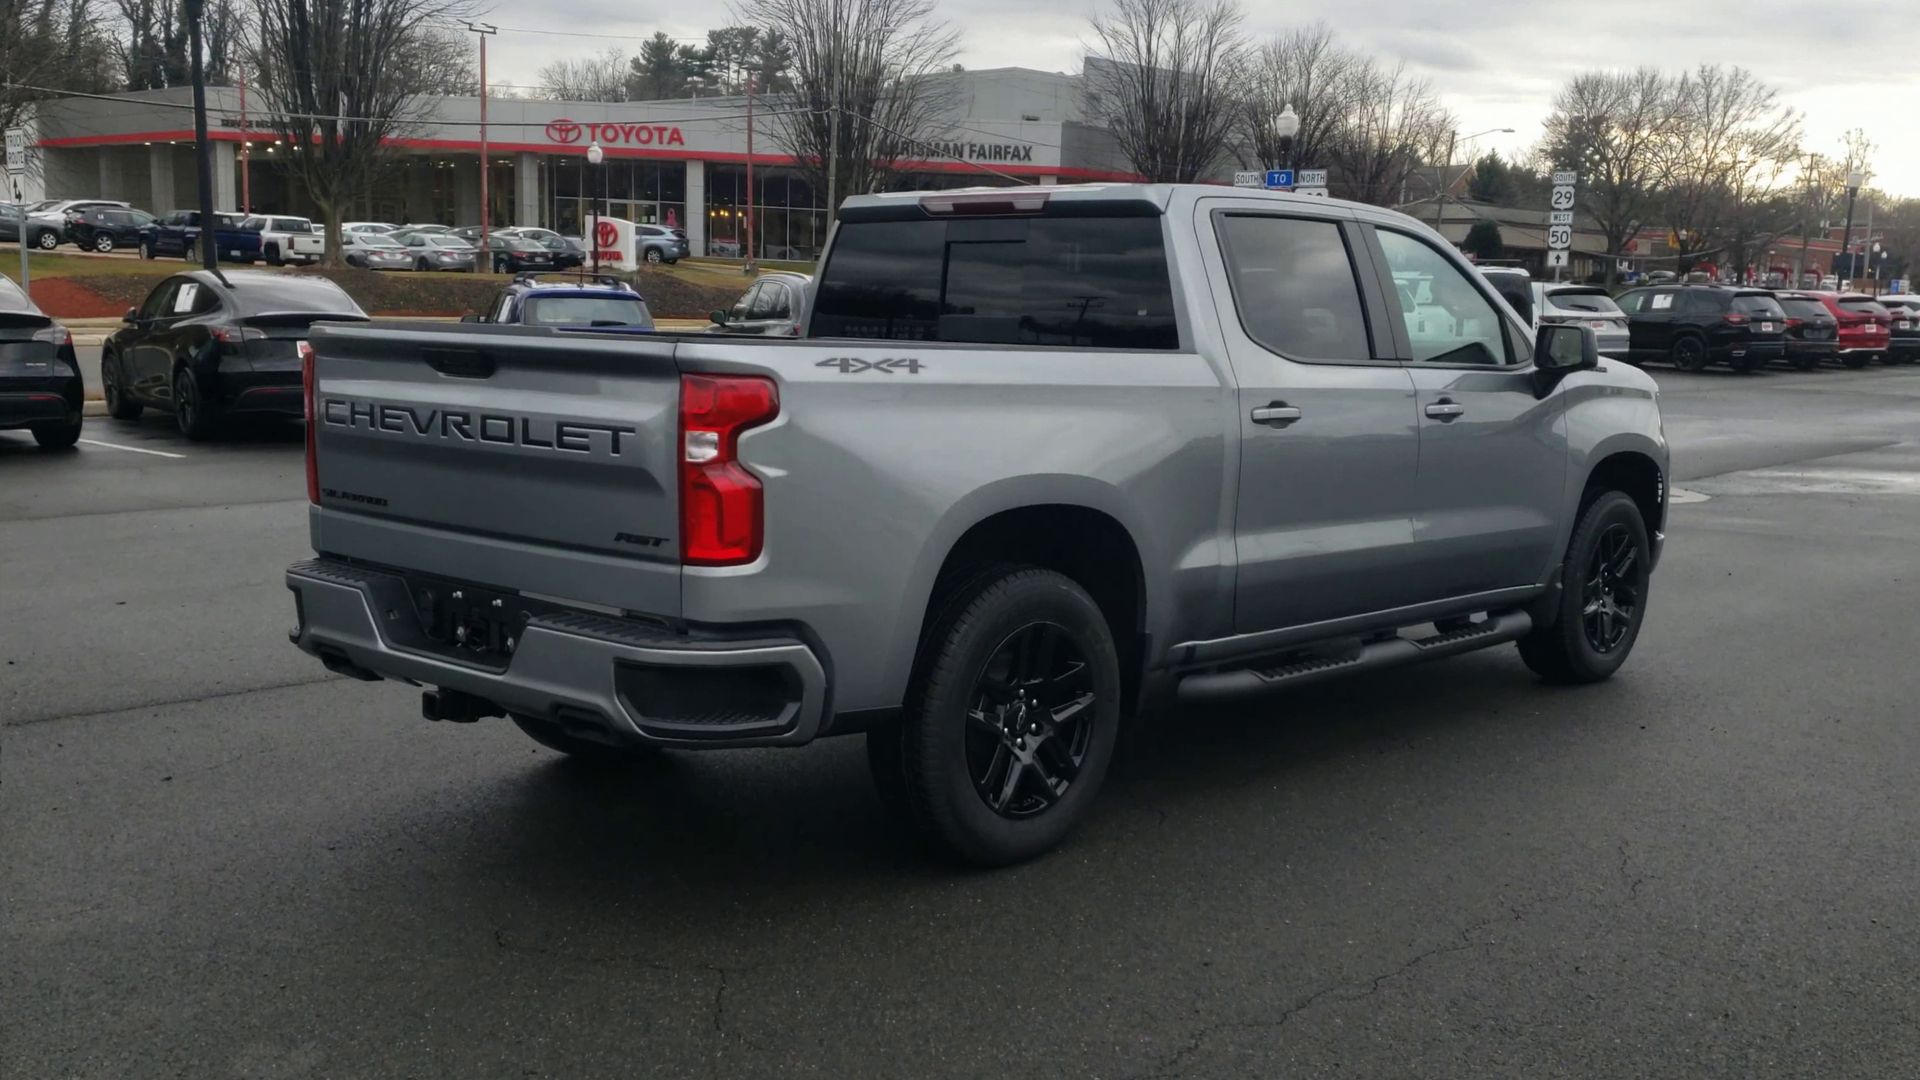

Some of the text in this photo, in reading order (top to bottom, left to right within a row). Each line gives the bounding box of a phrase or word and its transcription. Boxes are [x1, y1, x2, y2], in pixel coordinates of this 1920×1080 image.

[586, 123, 684, 146] TOYOTA
[8, 151, 24, 165] ROUTE
[969, 143, 1033, 162] FAIRFAX
[1235, 174, 1259, 184] SOUTH
[1273, 174, 1287, 183] TO
[1299, 172, 1325, 183] NORTH
[1555, 173, 1576, 183] SOUTH
[1554, 191, 1573, 204] 29
[1553, 213, 1570, 222] WEST
[1551, 230, 1569, 244] 50
[588, 250, 623, 262] TYOTA
[324, 398, 637, 457] CHEVROLET
[614, 531, 671, 548] RST
